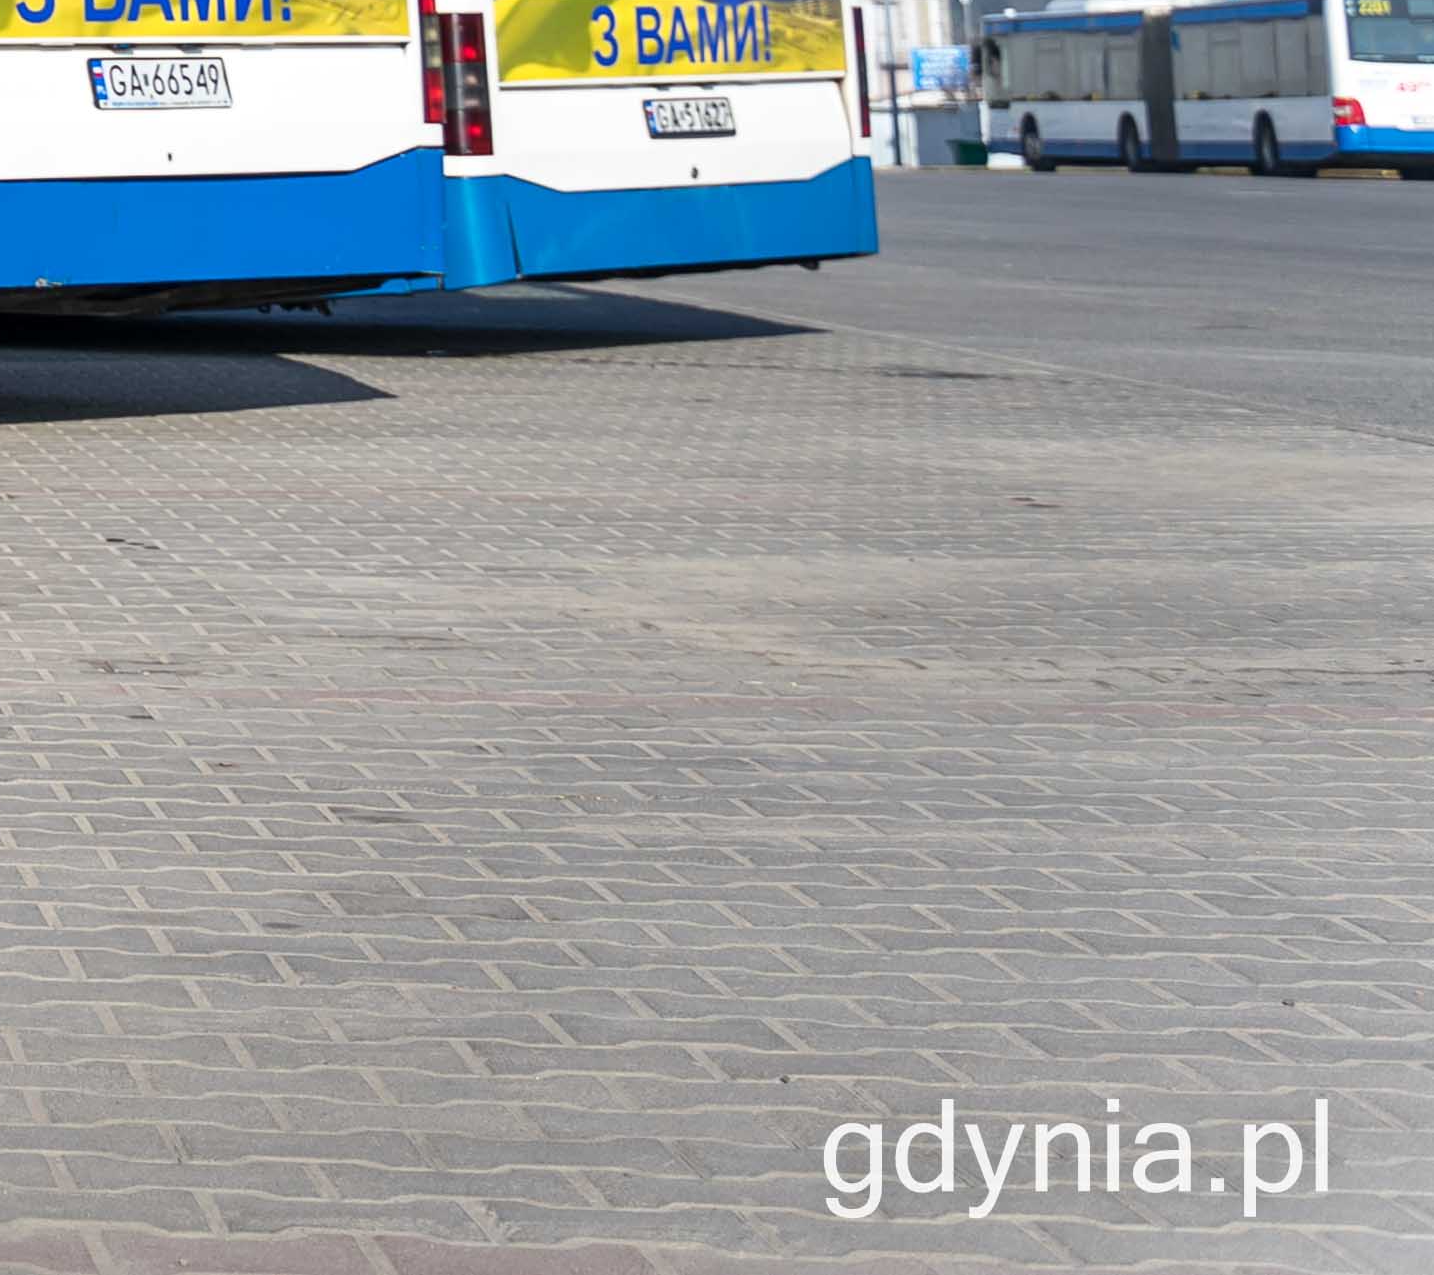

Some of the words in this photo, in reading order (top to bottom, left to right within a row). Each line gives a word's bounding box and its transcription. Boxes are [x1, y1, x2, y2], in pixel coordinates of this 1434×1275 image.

[592, 5, 619, 67] З
[636, 4, 772, 65] ВАМИ!
[109, 64, 146, 97] GA
[152, 64, 220, 96] 66549
